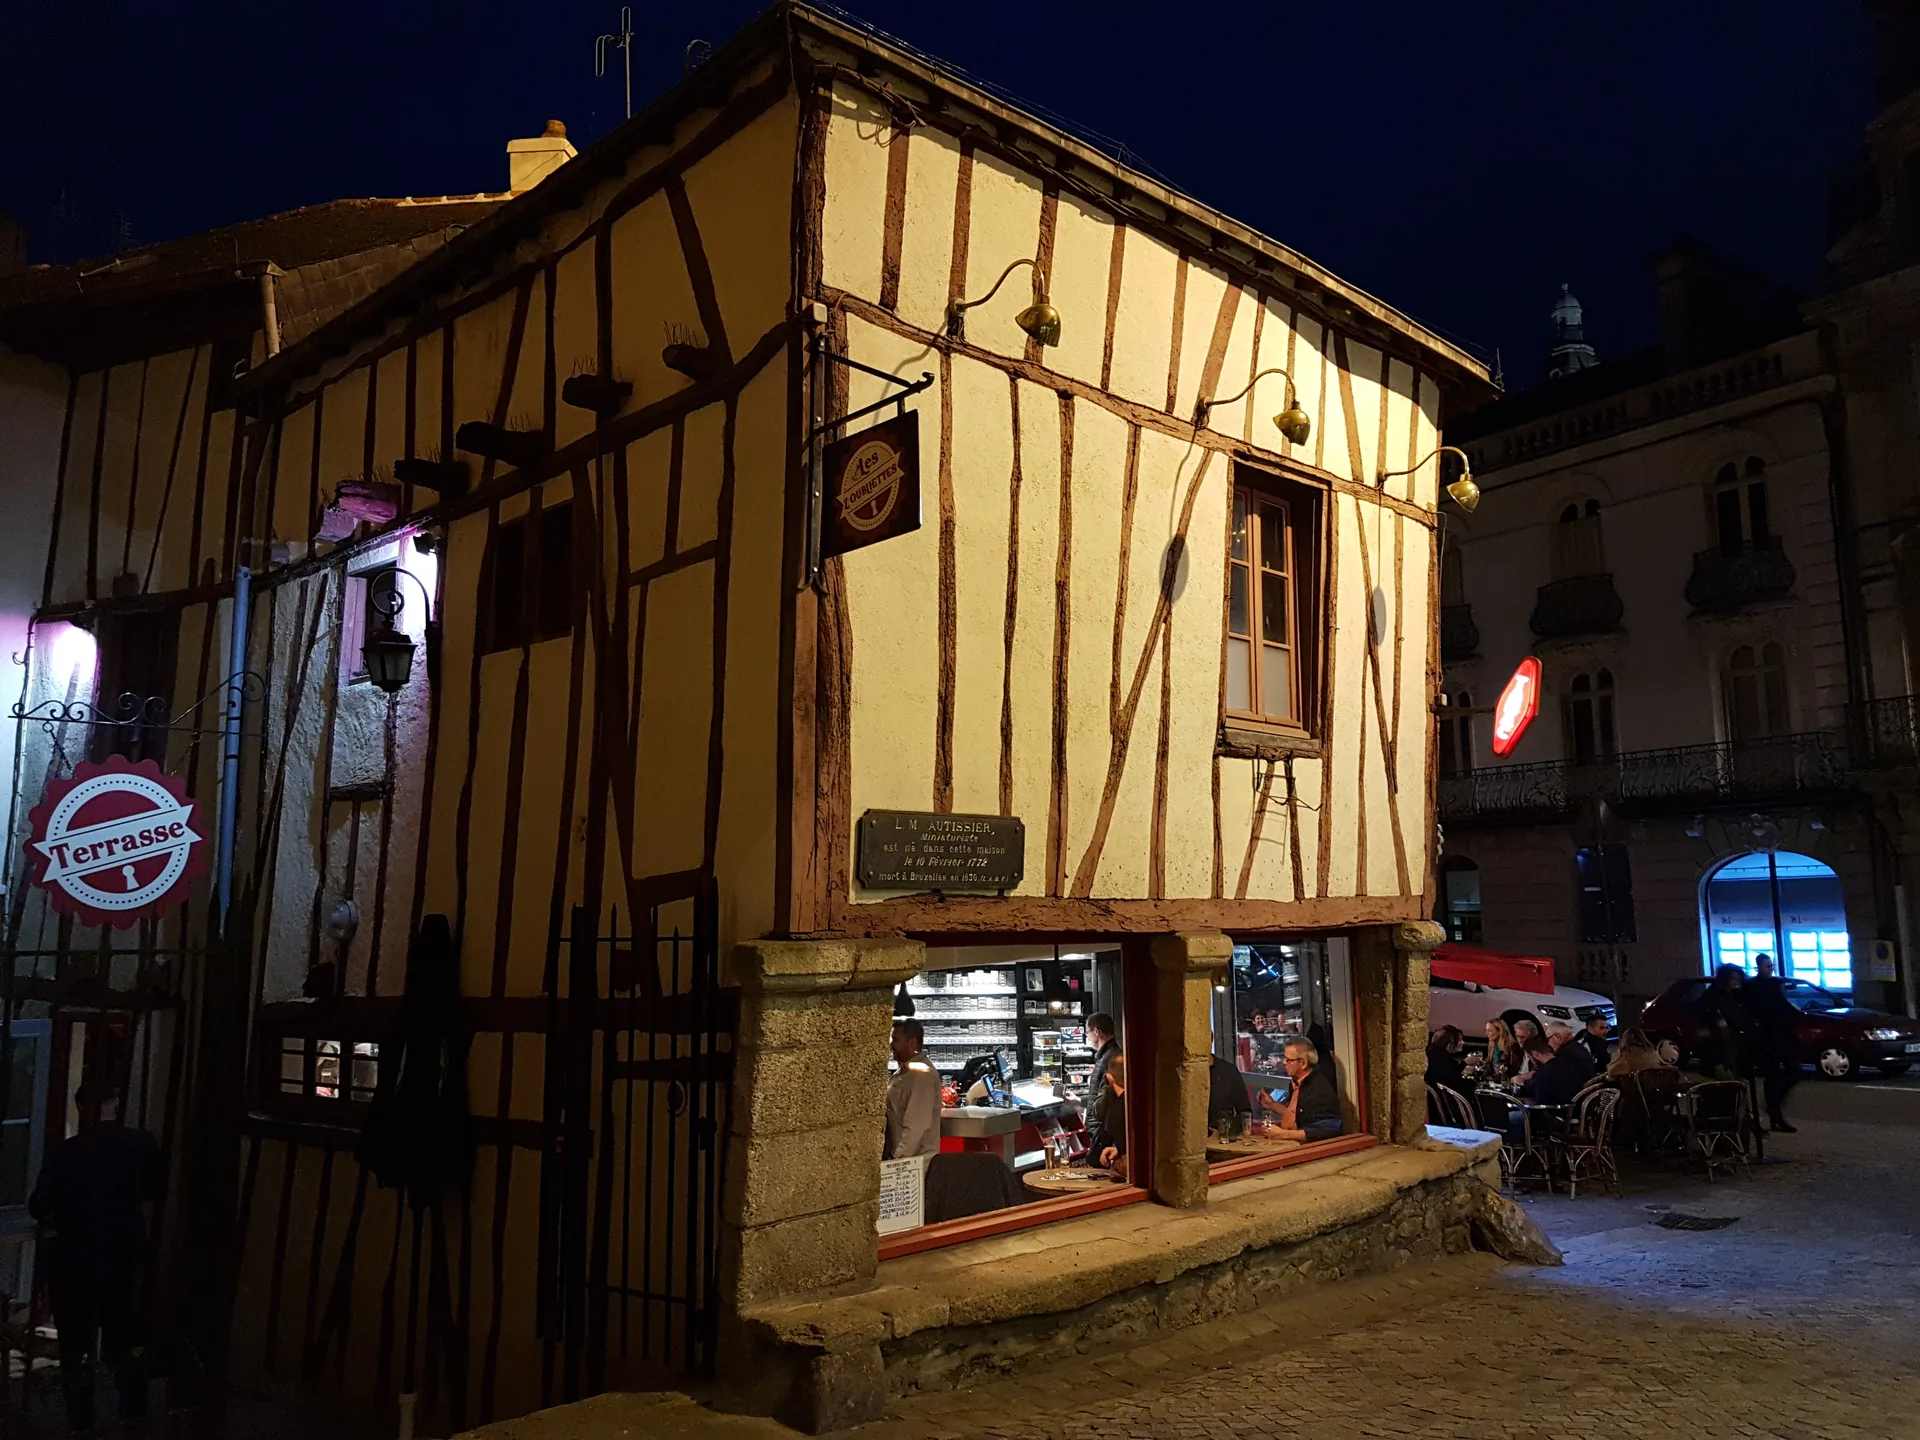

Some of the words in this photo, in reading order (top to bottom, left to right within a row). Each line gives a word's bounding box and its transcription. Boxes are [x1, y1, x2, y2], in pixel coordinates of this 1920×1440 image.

[855, 452, 879, 477] Les
[920, 833, 979, 843] Miniaturiste
[50, 821, 185, 869] Terrasse
[883, 843, 898, 852] est
[904, 842, 916, 852] né
[923, 843, 944, 853] dans
[949, 844, 972, 854] cette
[976, 844, 1006, 855] maison
[904, 856, 913, 866] le
[916, 857, 925, 867] 10
[966, 858, 988, 867] 1772
[878, 871, 900, 881] mort
[910, 872, 947, 882] Bruxelles
[950, 874, 959, 882] en
